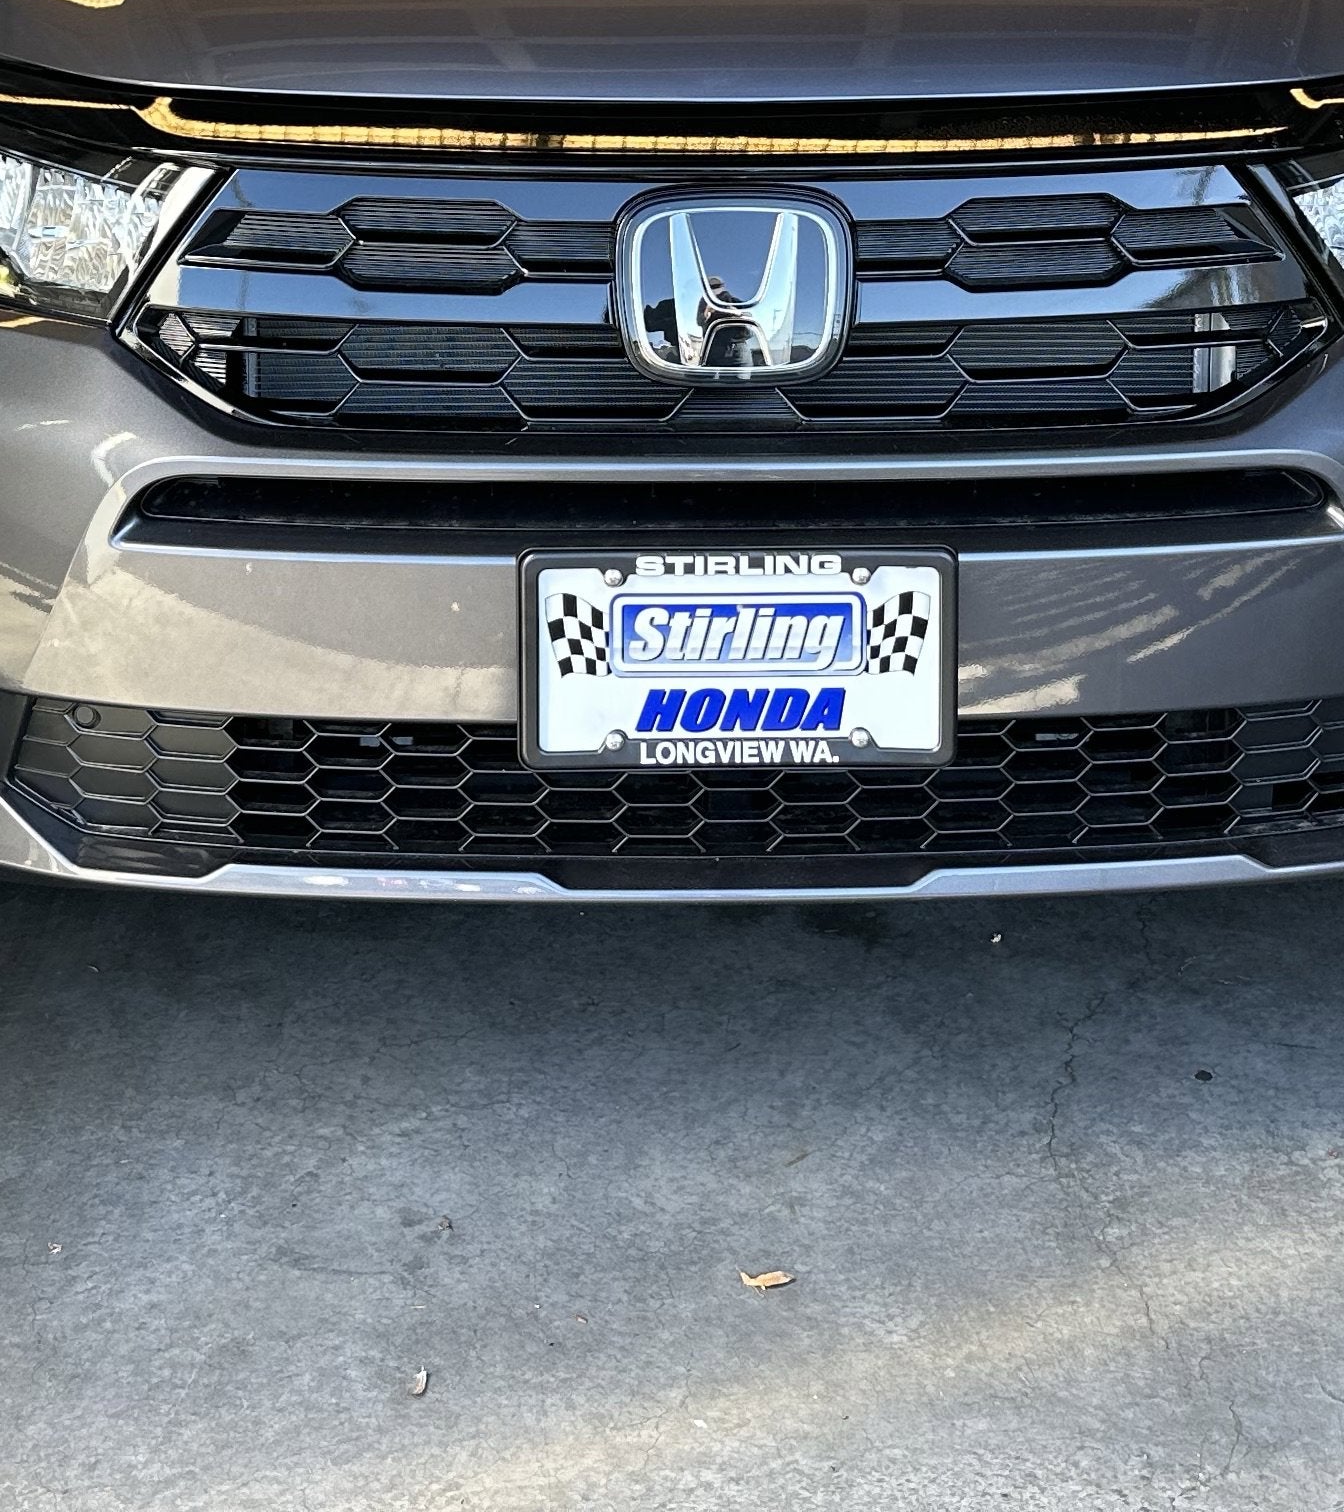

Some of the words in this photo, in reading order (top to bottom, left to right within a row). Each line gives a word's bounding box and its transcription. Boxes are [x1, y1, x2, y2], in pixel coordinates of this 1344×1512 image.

[635, 554, 843, 576] STIRLING
[628, 607, 846, 672] Stirling
[635, 688, 846, 732] HONDA
[640, 741, 788, 764] LONGVIEW
[789, 741, 840, 764] WA.
